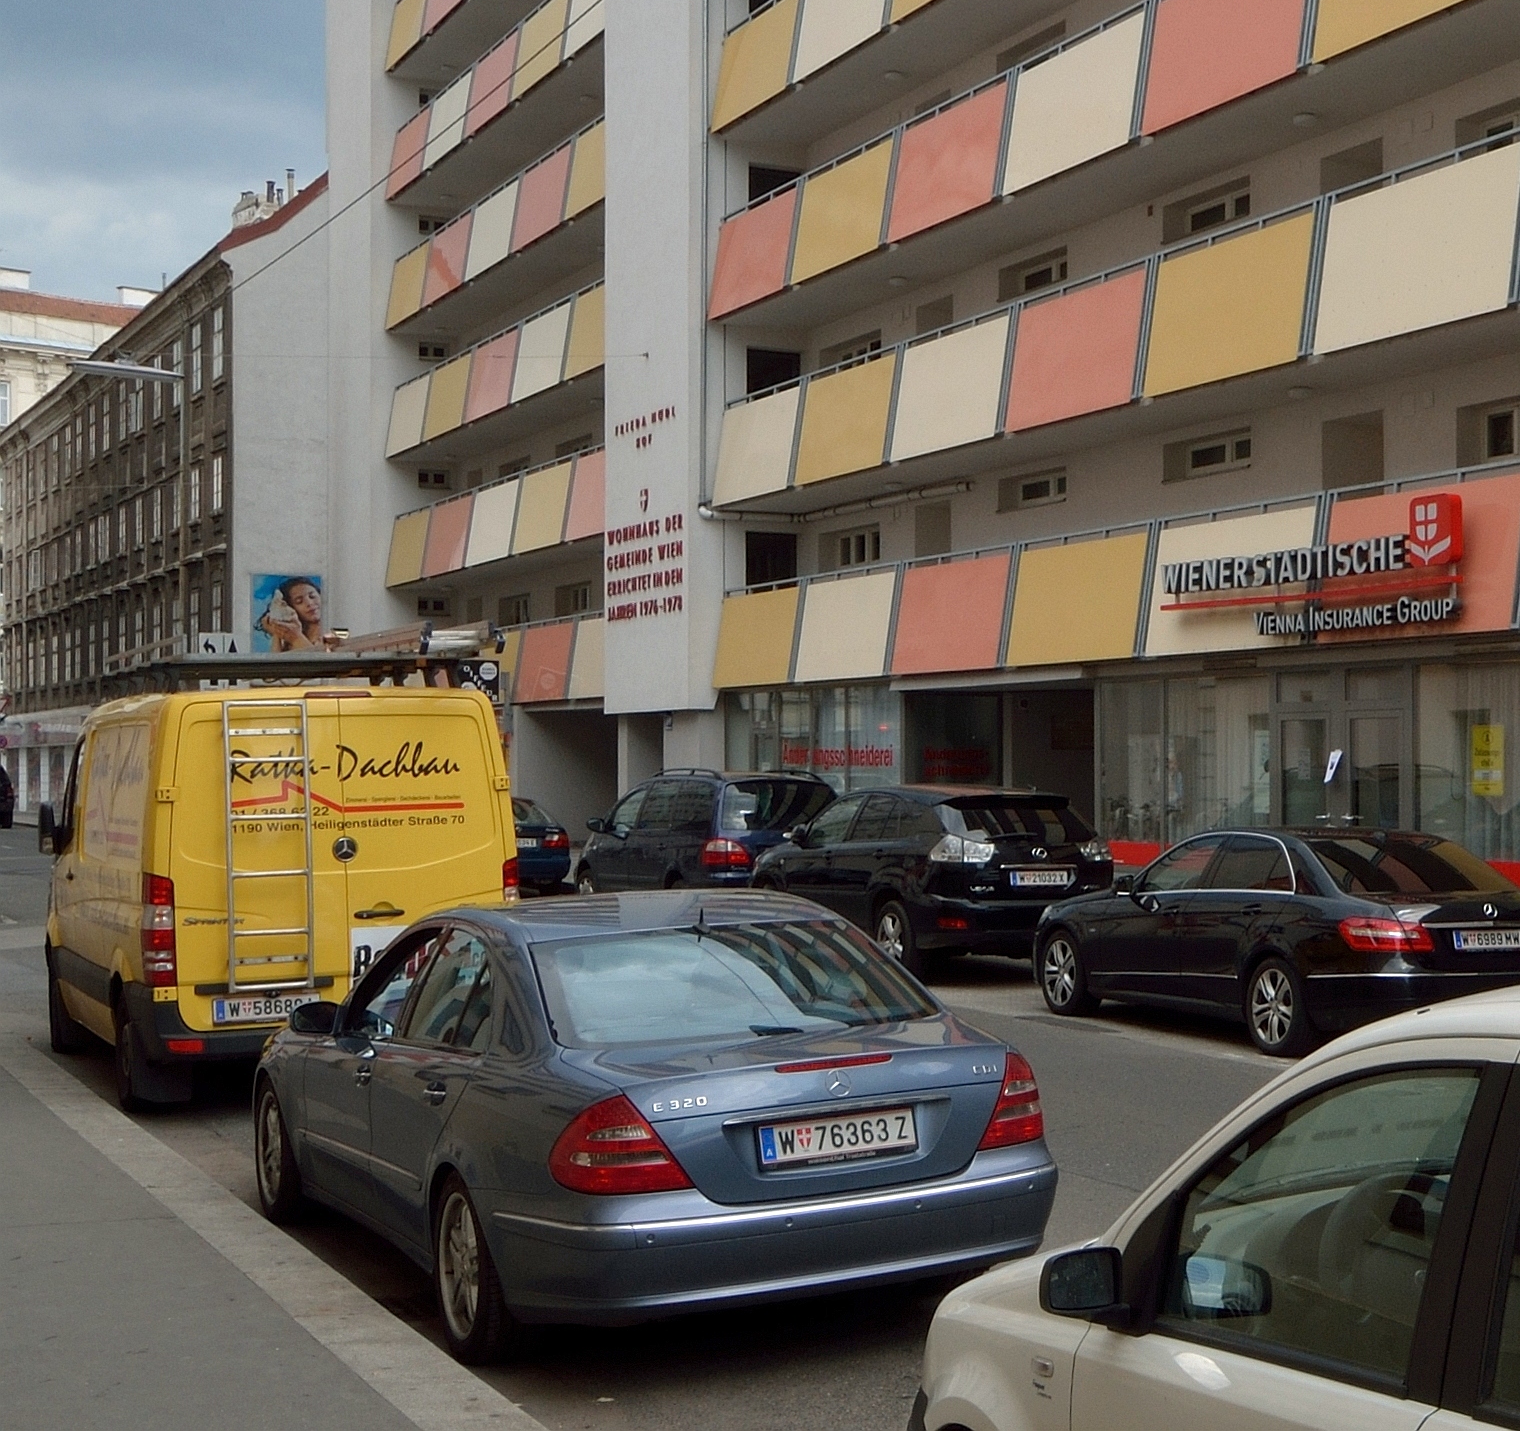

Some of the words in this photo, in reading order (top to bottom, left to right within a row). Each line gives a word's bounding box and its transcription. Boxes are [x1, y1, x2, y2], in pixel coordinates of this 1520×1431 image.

[607, 519, 660, 546] WOHNHAUS
[665, 513, 683, 533] DER
[607, 547, 653, 572] GEMEINDE
[657, 540, 683, 561] WIEN
[1161, 555, 1249, 594] WIENER
[1251, 534, 1407, 588] STÄDTISCHE
[607, 573, 652, 597] ERRICHTET
[653, 572, 663, 588] IN
[664, 567, 683, 587] DEN
[607, 602, 637, 622] JAHREN
[639, 594, 683, 617] 1976-1978
[313, 806, 330, 817] 22
[232, 823, 262, 833] 1190
[266, 822, 304, 832] Wien,
[408, 815, 448, 826] Straße
[451, 814, 465, 824] 70
[1032, 872, 1058, 883] 21032
[1477, 932, 1503, 946] 6989
[229, 1002, 240, 1017] W
[972, 1064, 999, 1075] CDI
[653, 1102, 664, 1112] E
[670, 1095, 708, 1111] 320
[778, 1128, 796, 1156] W
[814, 1117, 890, 1151] 76363
[896, 1115, 909, 1140] Z
